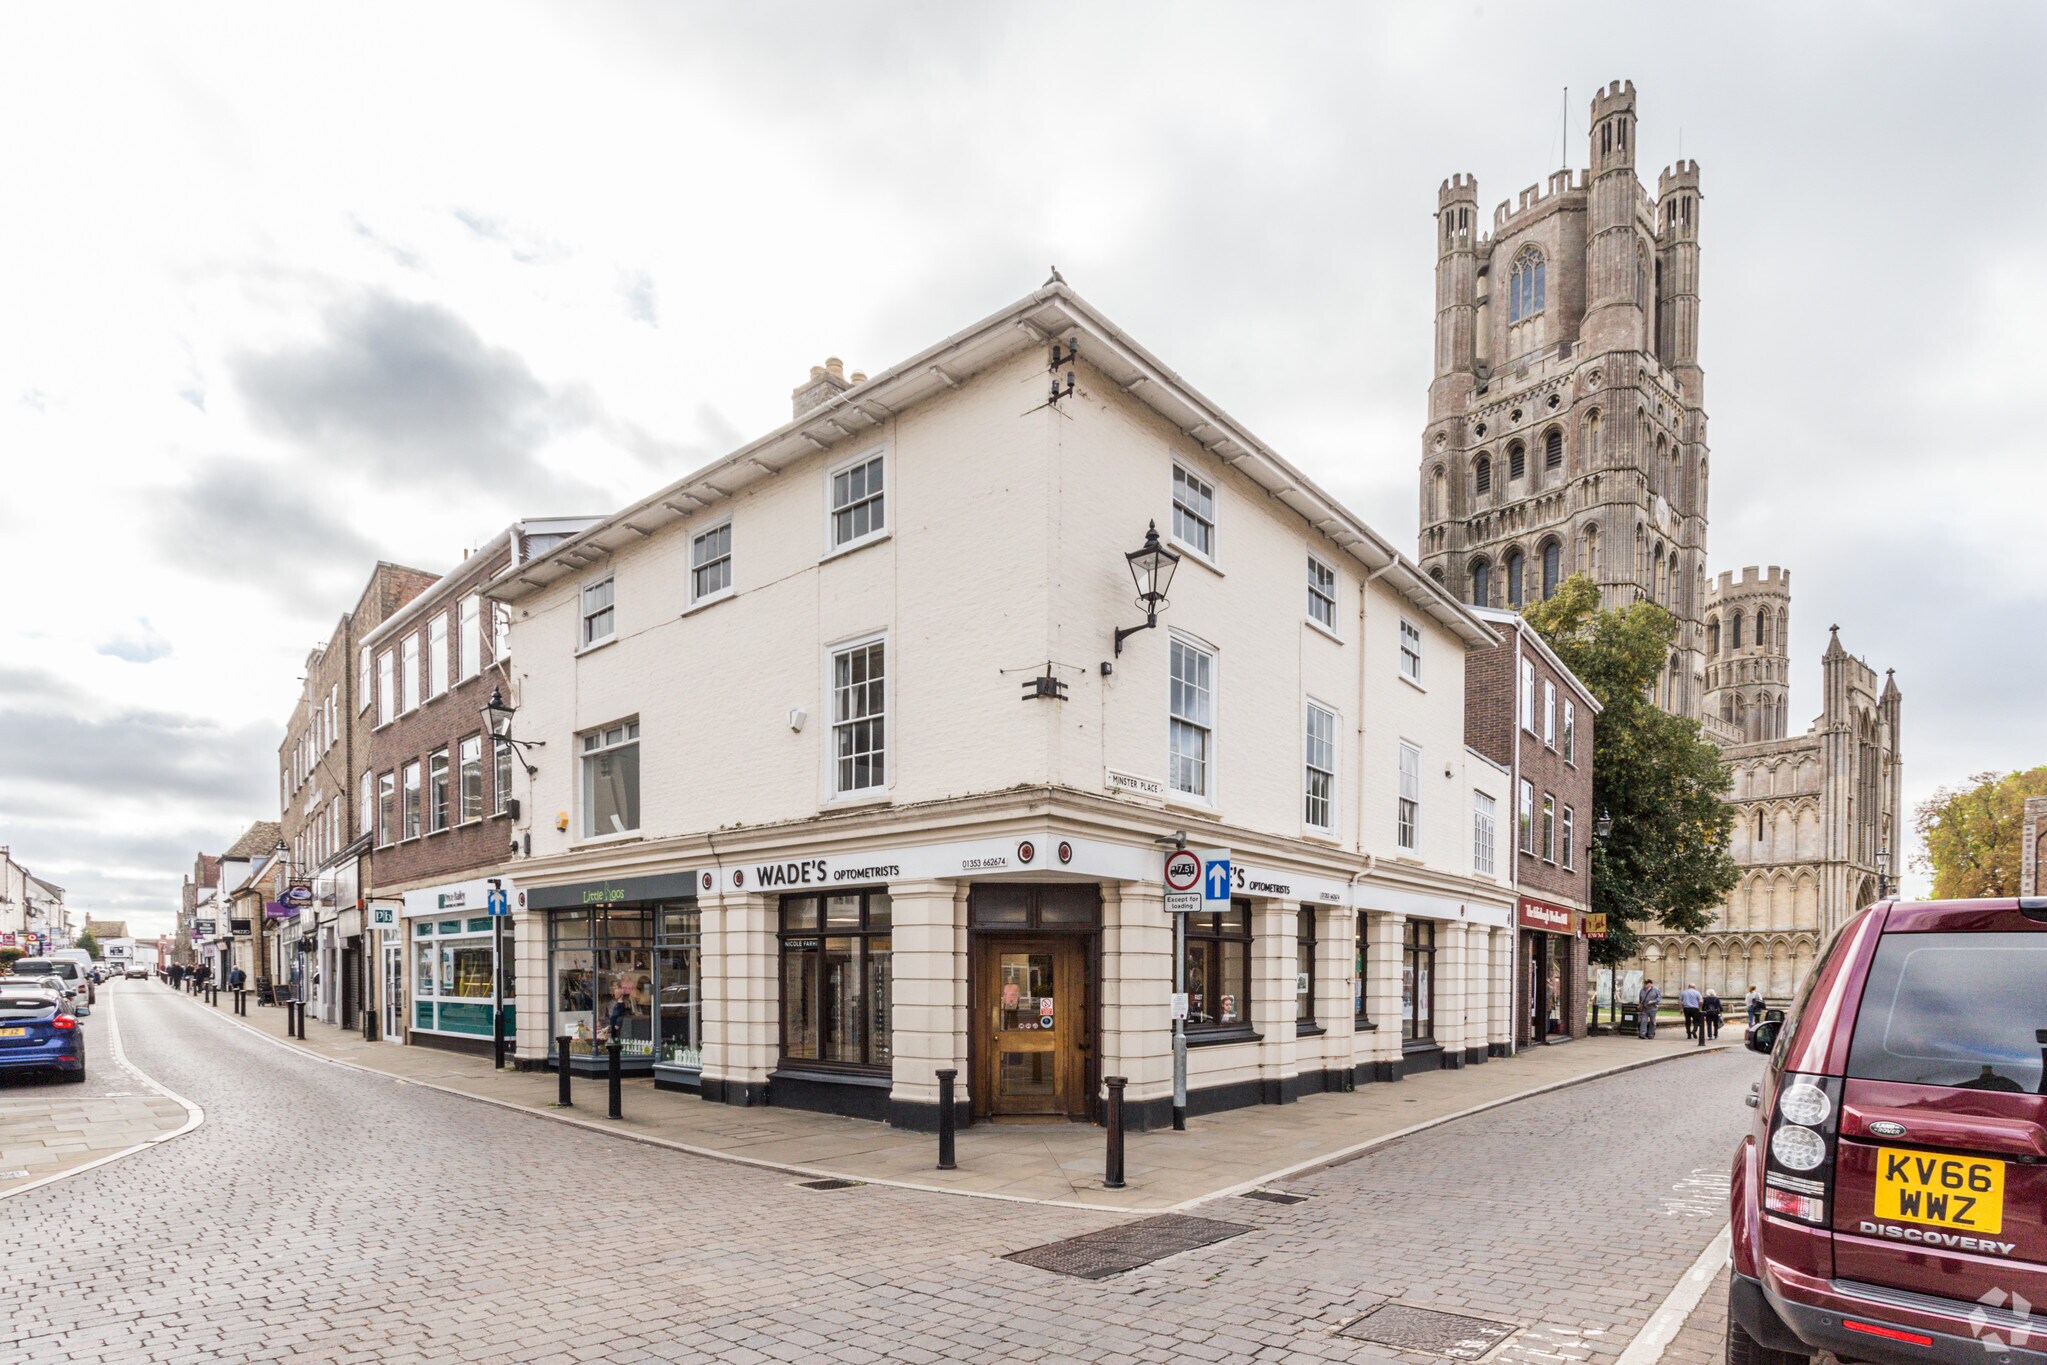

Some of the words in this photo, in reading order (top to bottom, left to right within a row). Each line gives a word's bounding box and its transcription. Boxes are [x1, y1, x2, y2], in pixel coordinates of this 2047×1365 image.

[1112, 774, 1138, 789] MINSTER
[1140, 781, 1158, 793] PLACE
[962, 859, 981, 869] 01353
[983, 857, 1006, 868] 662674
[1177, 863, 1195, 873] 7.5T
[756, 860, 827, 887] WADE'S
[834, 865, 900, 881] OPTOMETRISTS
[1249, 881, 1290, 894] OPTOMETRISTS
[583, 890, 603, 903] Little
[1167, 896, 1187, 904] Except
[1171, 902, 1194, 910] loading
[1878, 1127, 1901, 1135] ROVER
[1886, 1154, 1992, 1193] KV66
[1899, 1188, 1977, 1225] WWZ
[1859, 1221, 2016, 1256] DISCOVERY
